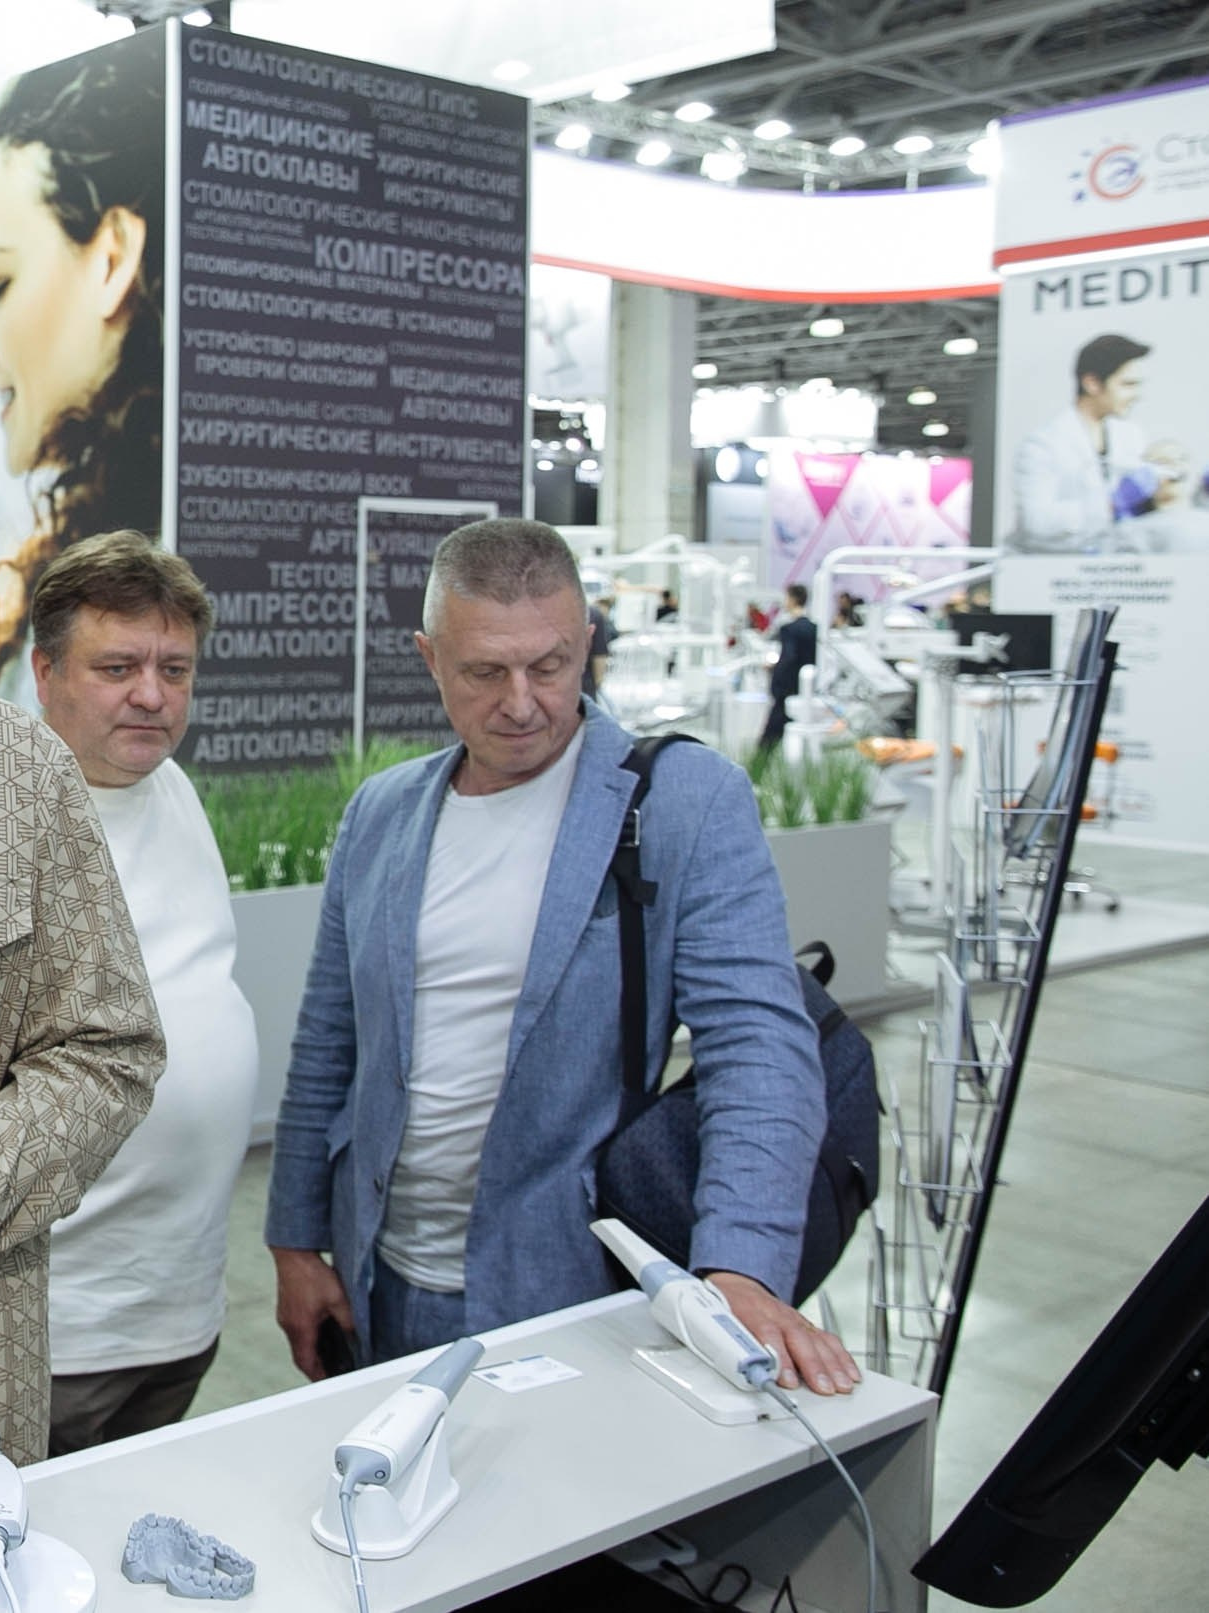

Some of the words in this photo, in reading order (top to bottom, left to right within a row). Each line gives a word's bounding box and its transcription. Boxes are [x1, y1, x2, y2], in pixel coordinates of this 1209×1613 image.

[186, 100, 375, 160] МЕДИЦИНСКИЕ
[202, 142, 360, 193] АВТОКЛАВЫ
[183, 179, 399, 236] СТОМАТОЛОГИЧЕСКИЕ
[314, 233, 524, 296] КОМПРЕССОРА
[1033, 259, 1209, 314] MEDIT
[183, 284, 394, 329] СТОМАТОЛОГИЧЕСКИЕ
[395, 310, 494, 340] УСТАНОВКИ
[182, 327, 295, 358] УСТРОЙСТВО
[195, 353, 286, 382] ПРОВЕРКИ
[181, 417, 374, 455] ХИРУРГИЧЕСКИЕ
[375, 430, 522, 464] ИНСТРУМЕНТЫ
[180, 463, 363, 494] ЗУБОТЕХНИЧЕСКИЙ
[365, 472, 413, 496] ВОСК
[267, 562, 387, 589] ТЕСТОВЕ
